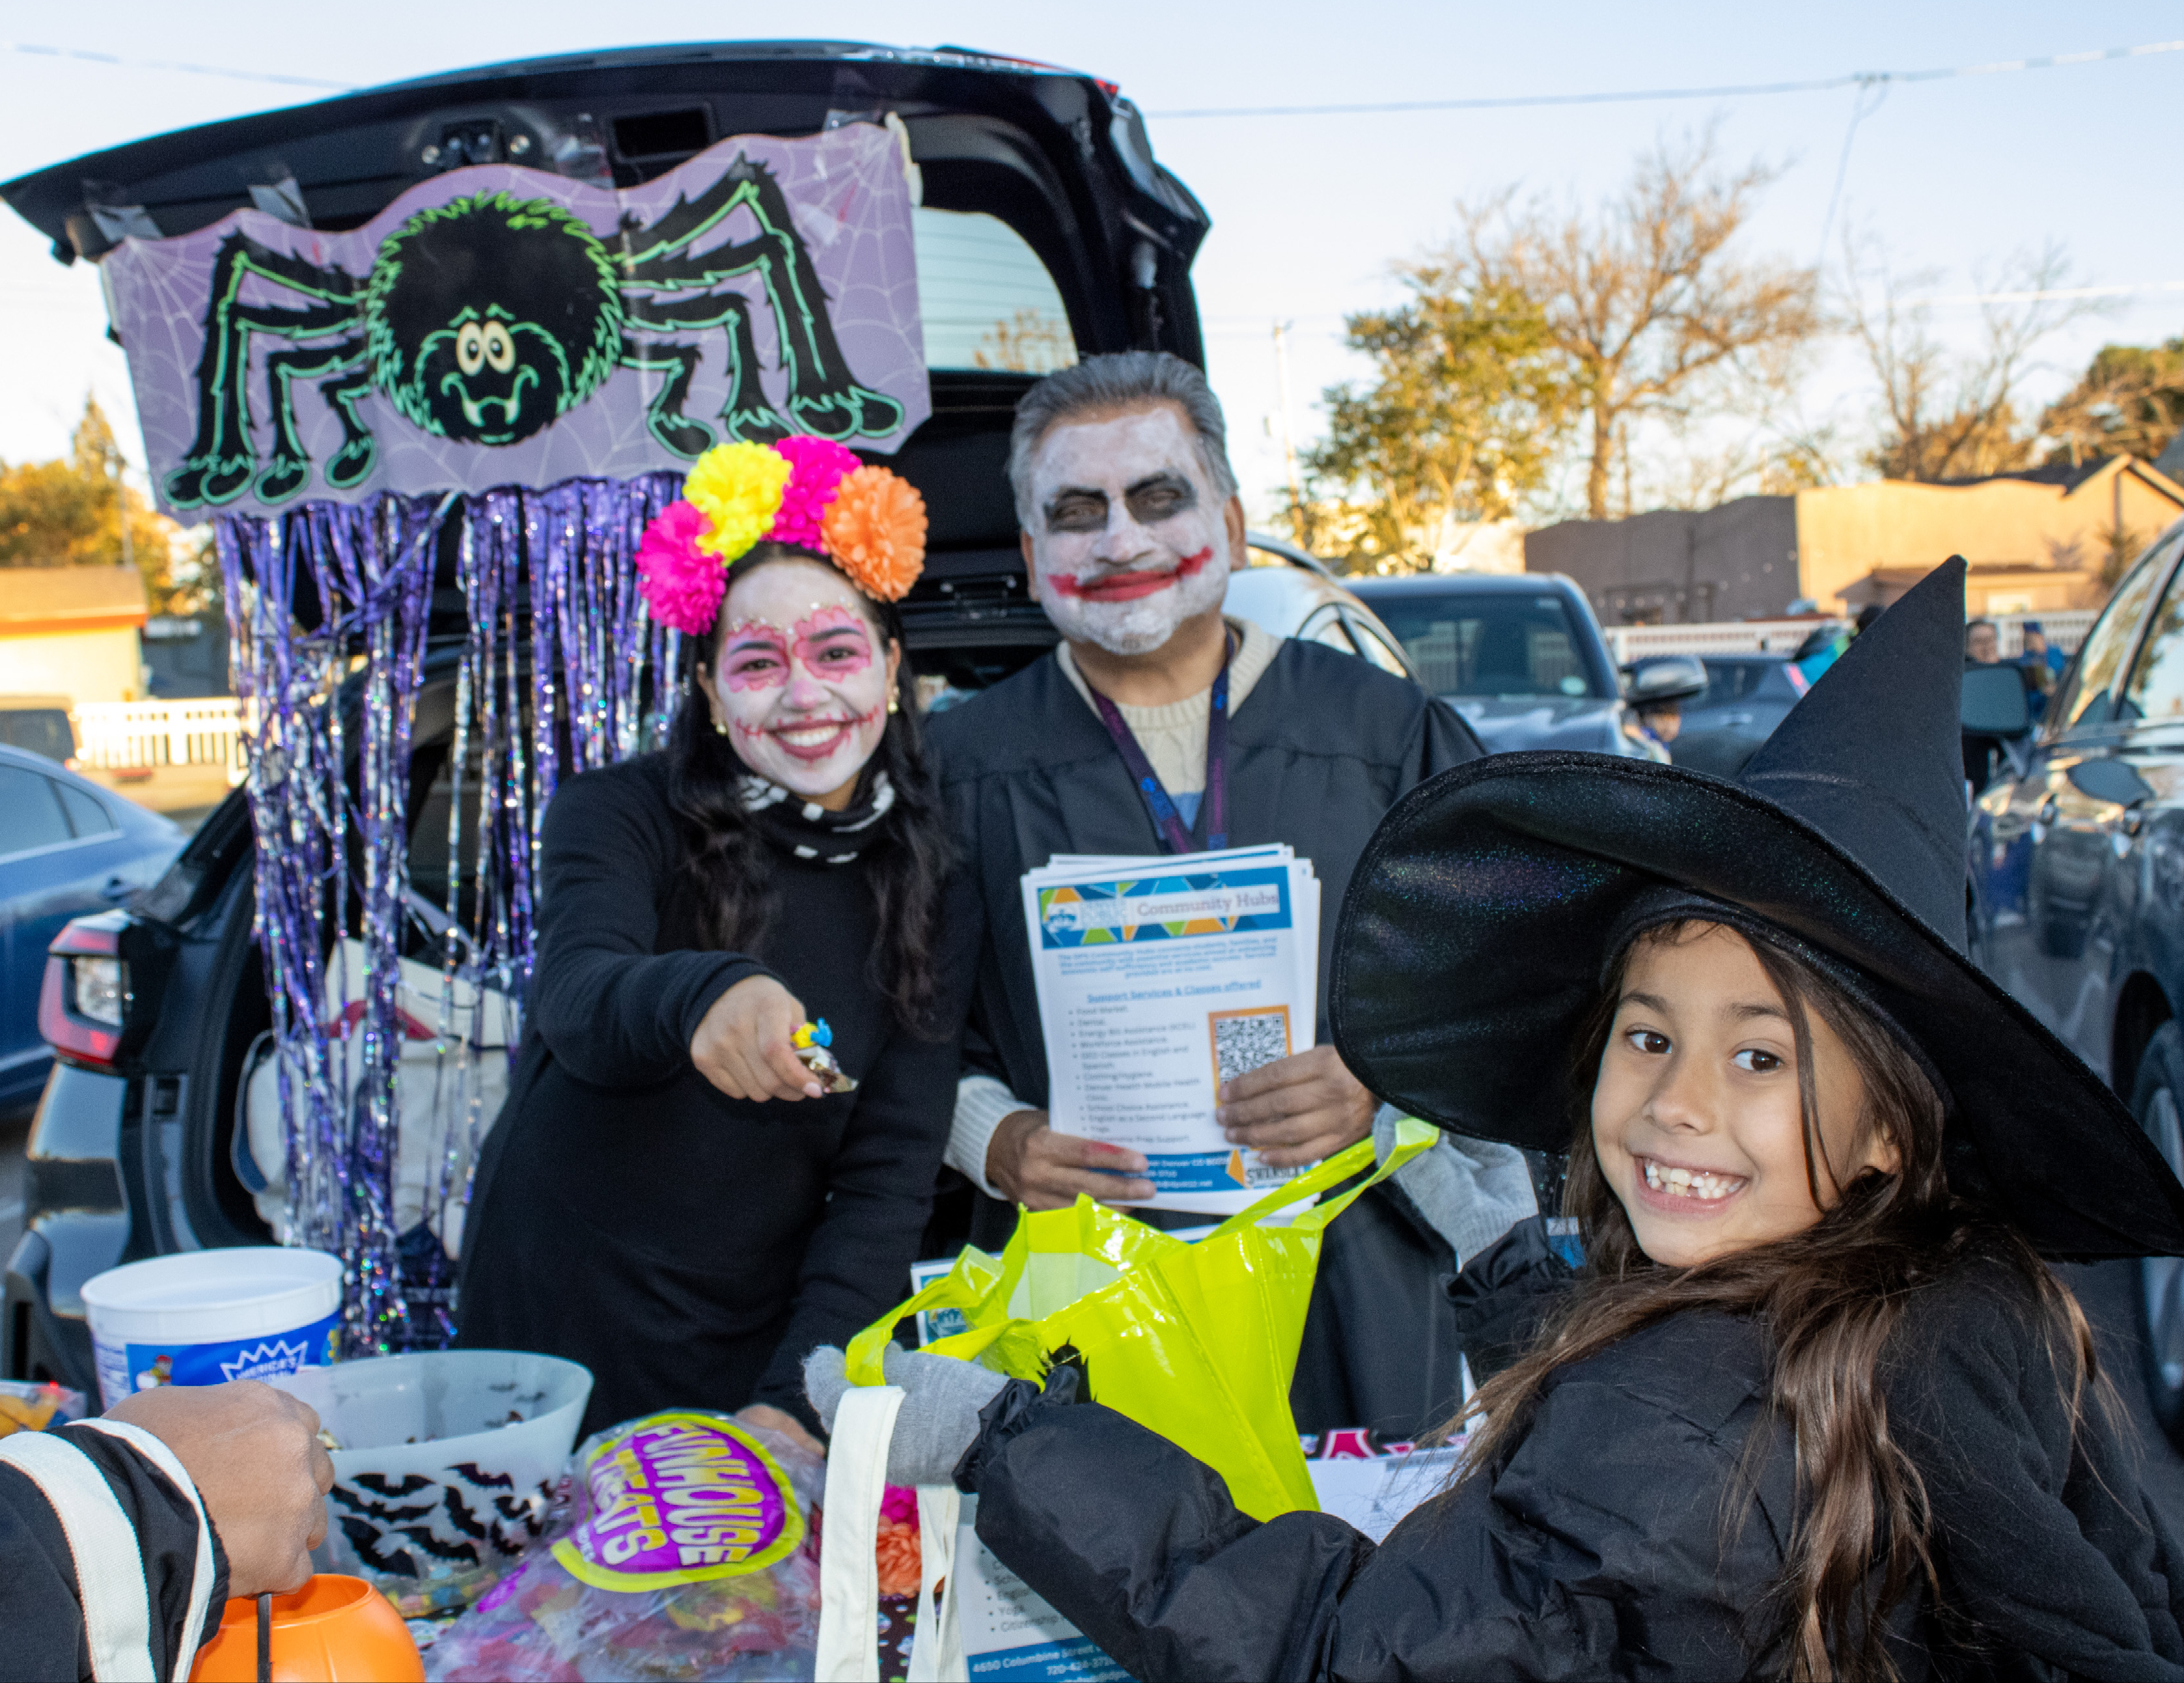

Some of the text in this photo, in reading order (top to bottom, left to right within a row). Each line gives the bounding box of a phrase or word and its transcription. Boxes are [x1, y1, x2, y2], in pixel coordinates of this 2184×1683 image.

[1137, 897, 1231, 917] Community
[1237, 892, 1279, 908] Hubs
[592, 1447, 669, 1566] TREATS
[635, 1421, 765, 1566] FUNHOUSE
